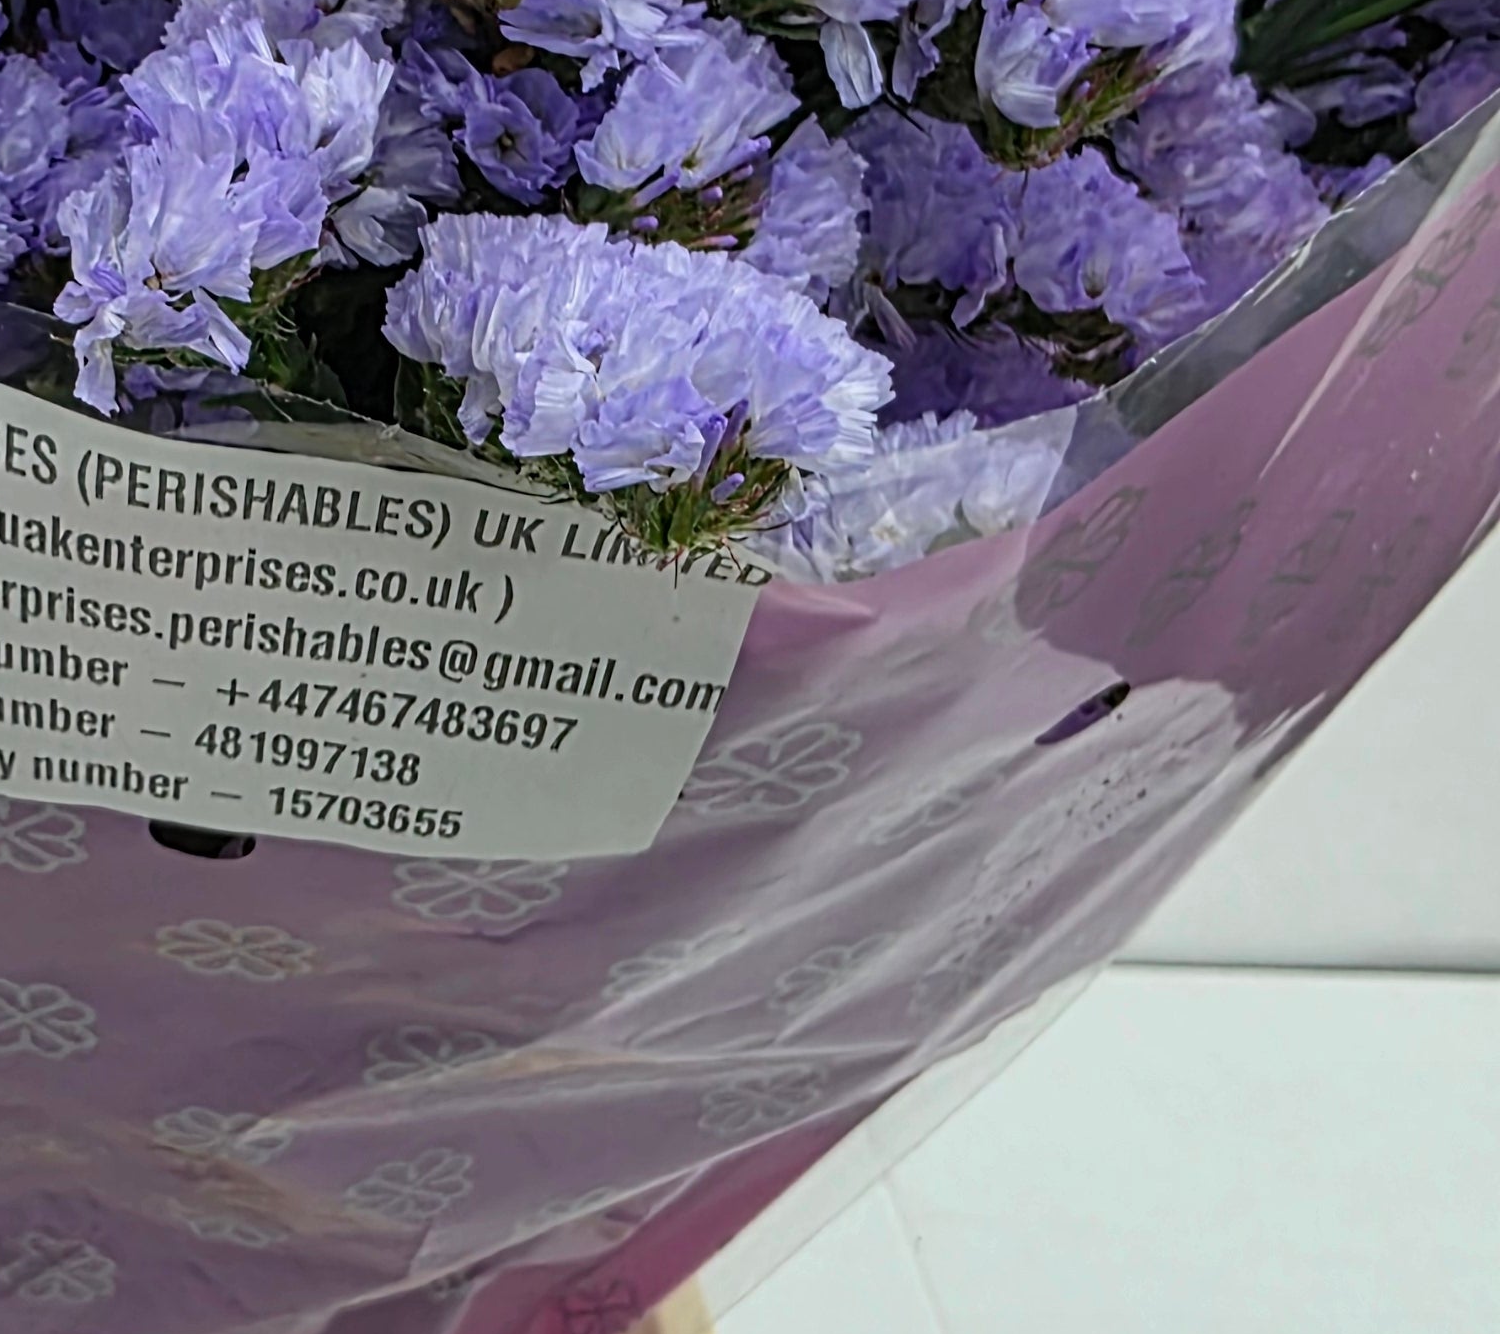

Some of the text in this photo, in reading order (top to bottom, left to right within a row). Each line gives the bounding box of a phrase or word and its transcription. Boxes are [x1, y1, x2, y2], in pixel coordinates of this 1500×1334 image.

[77, 449, 452, 551] (PERISHABLES)
[474, 509, 546, 554] UK
[194, 722, 421, 787] 481997138
[216, 676, 579, 753] +447467483697
[32, 755, 188, 802] number
[268, 786, 463, 840] 15703655
